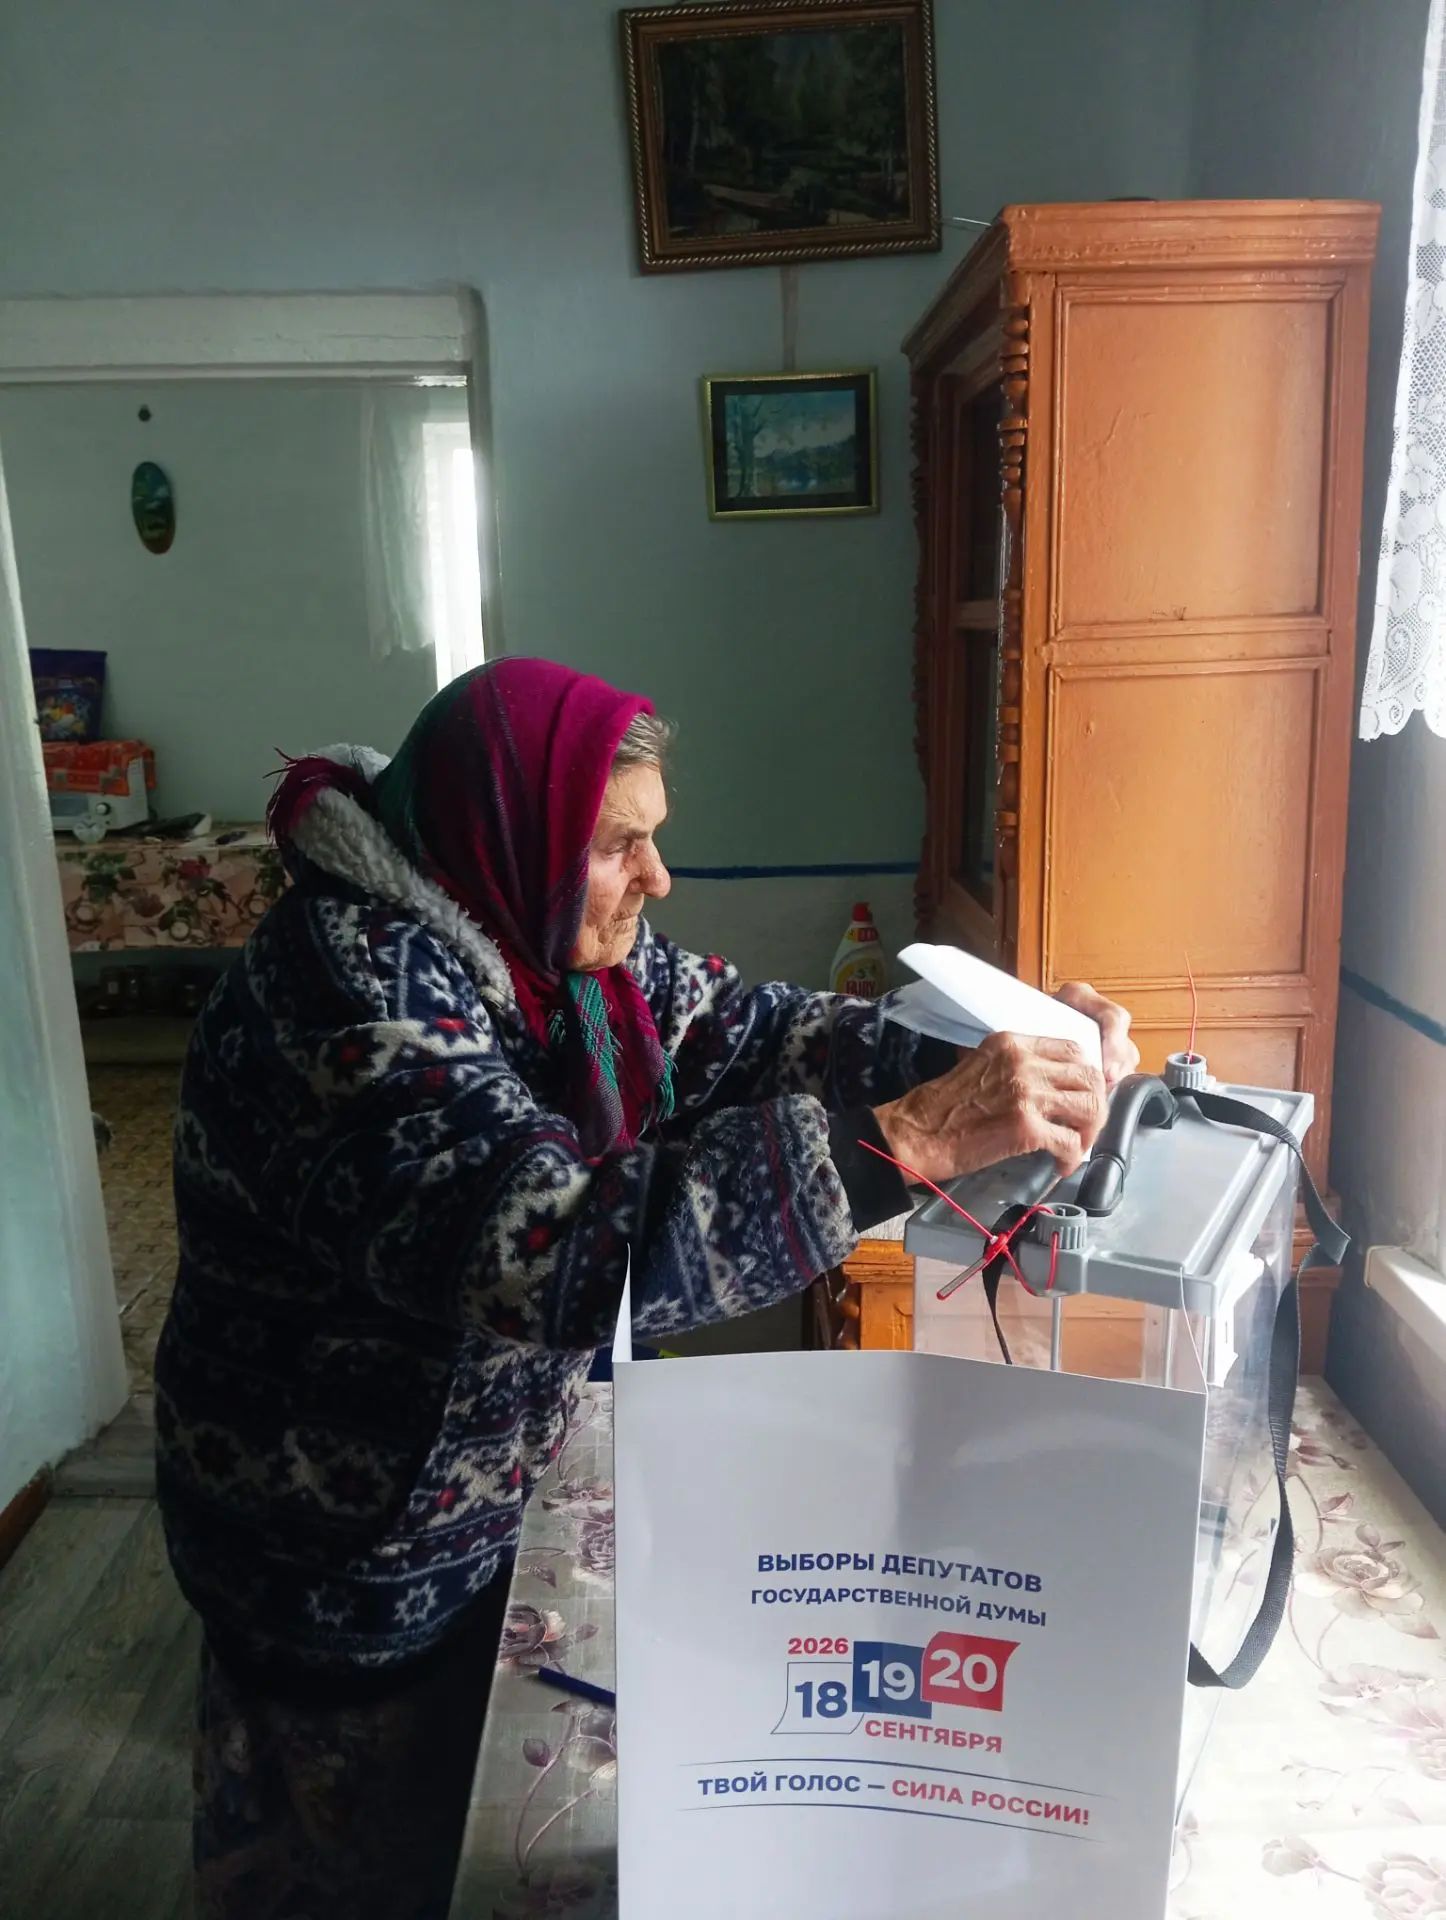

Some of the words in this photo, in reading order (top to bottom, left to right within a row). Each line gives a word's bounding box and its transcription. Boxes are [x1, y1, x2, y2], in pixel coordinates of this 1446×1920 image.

[757, 1553, 874, 1572] ВЫБОРЫ
[882, 1554, 1042, 1592] ДЕПУТАТОВ
[751, 1588, 971, 1615] ГОСУДАРСТВЕННОЙ
[977, 1602, 1046, 1627] ДУМЫ
[788, 1638, 849, 1655] 2026
[795, 1681, 847, 1718] 18
[861, 1660, 915, 1700] 19
[929, 1649, 997, 1692] 20
[865, 1720, 1002, 1753] СЕНТЯБРЯ
[697, 1772, 767, 1795] ТВОЙ
[775, 1774, 861, 1792] ГОЛОС
[892, 1780, 963, 1804] СИЛА
[971, 1794, 1089, 1826] РОССИИ!
